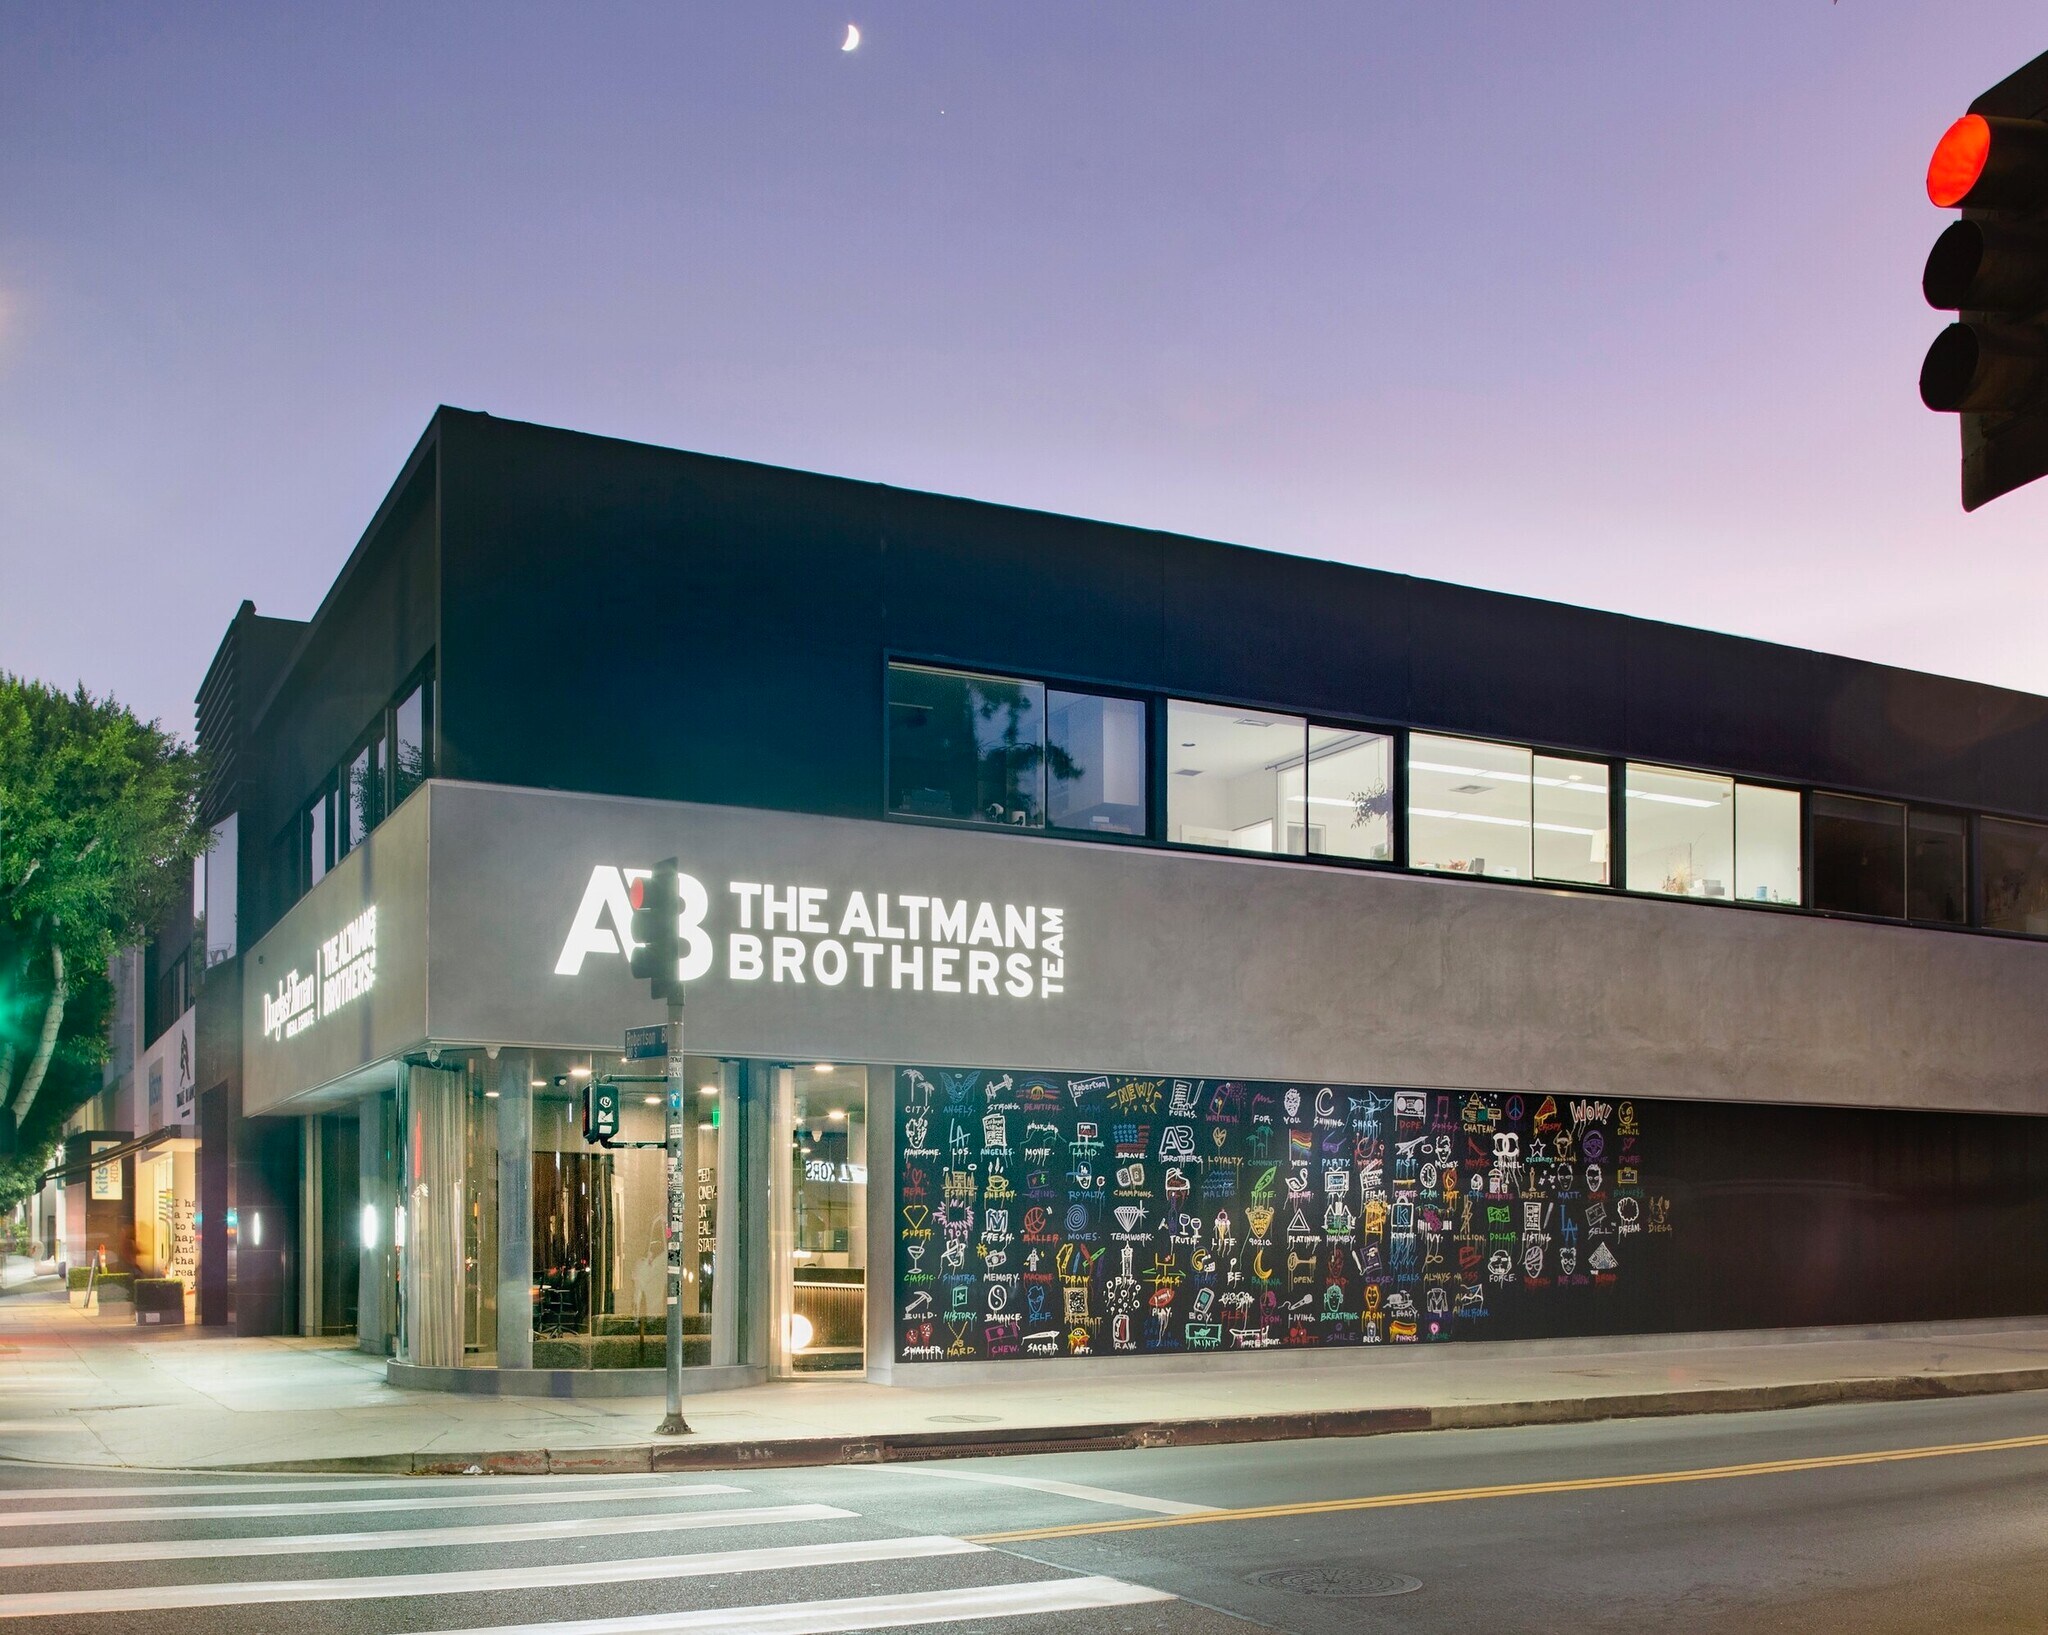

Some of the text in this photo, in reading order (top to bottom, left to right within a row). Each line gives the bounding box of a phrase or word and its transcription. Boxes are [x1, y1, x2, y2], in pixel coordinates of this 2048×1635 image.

[730, 882, 1035, 949] THE ALTMAN
[730, 933, 1034, 998] BROTHERS
[1041, 907, 1065, 998] TEAM
[324, 952, 373, 1017] BROTHERS
[626, 1031, 656, 1048] Robertson
[1118, 1080, 1155, 1103] NEW!
[1570, 1099, 1612, 1125] WOW!
[174, 1222, 186, 1230] to
